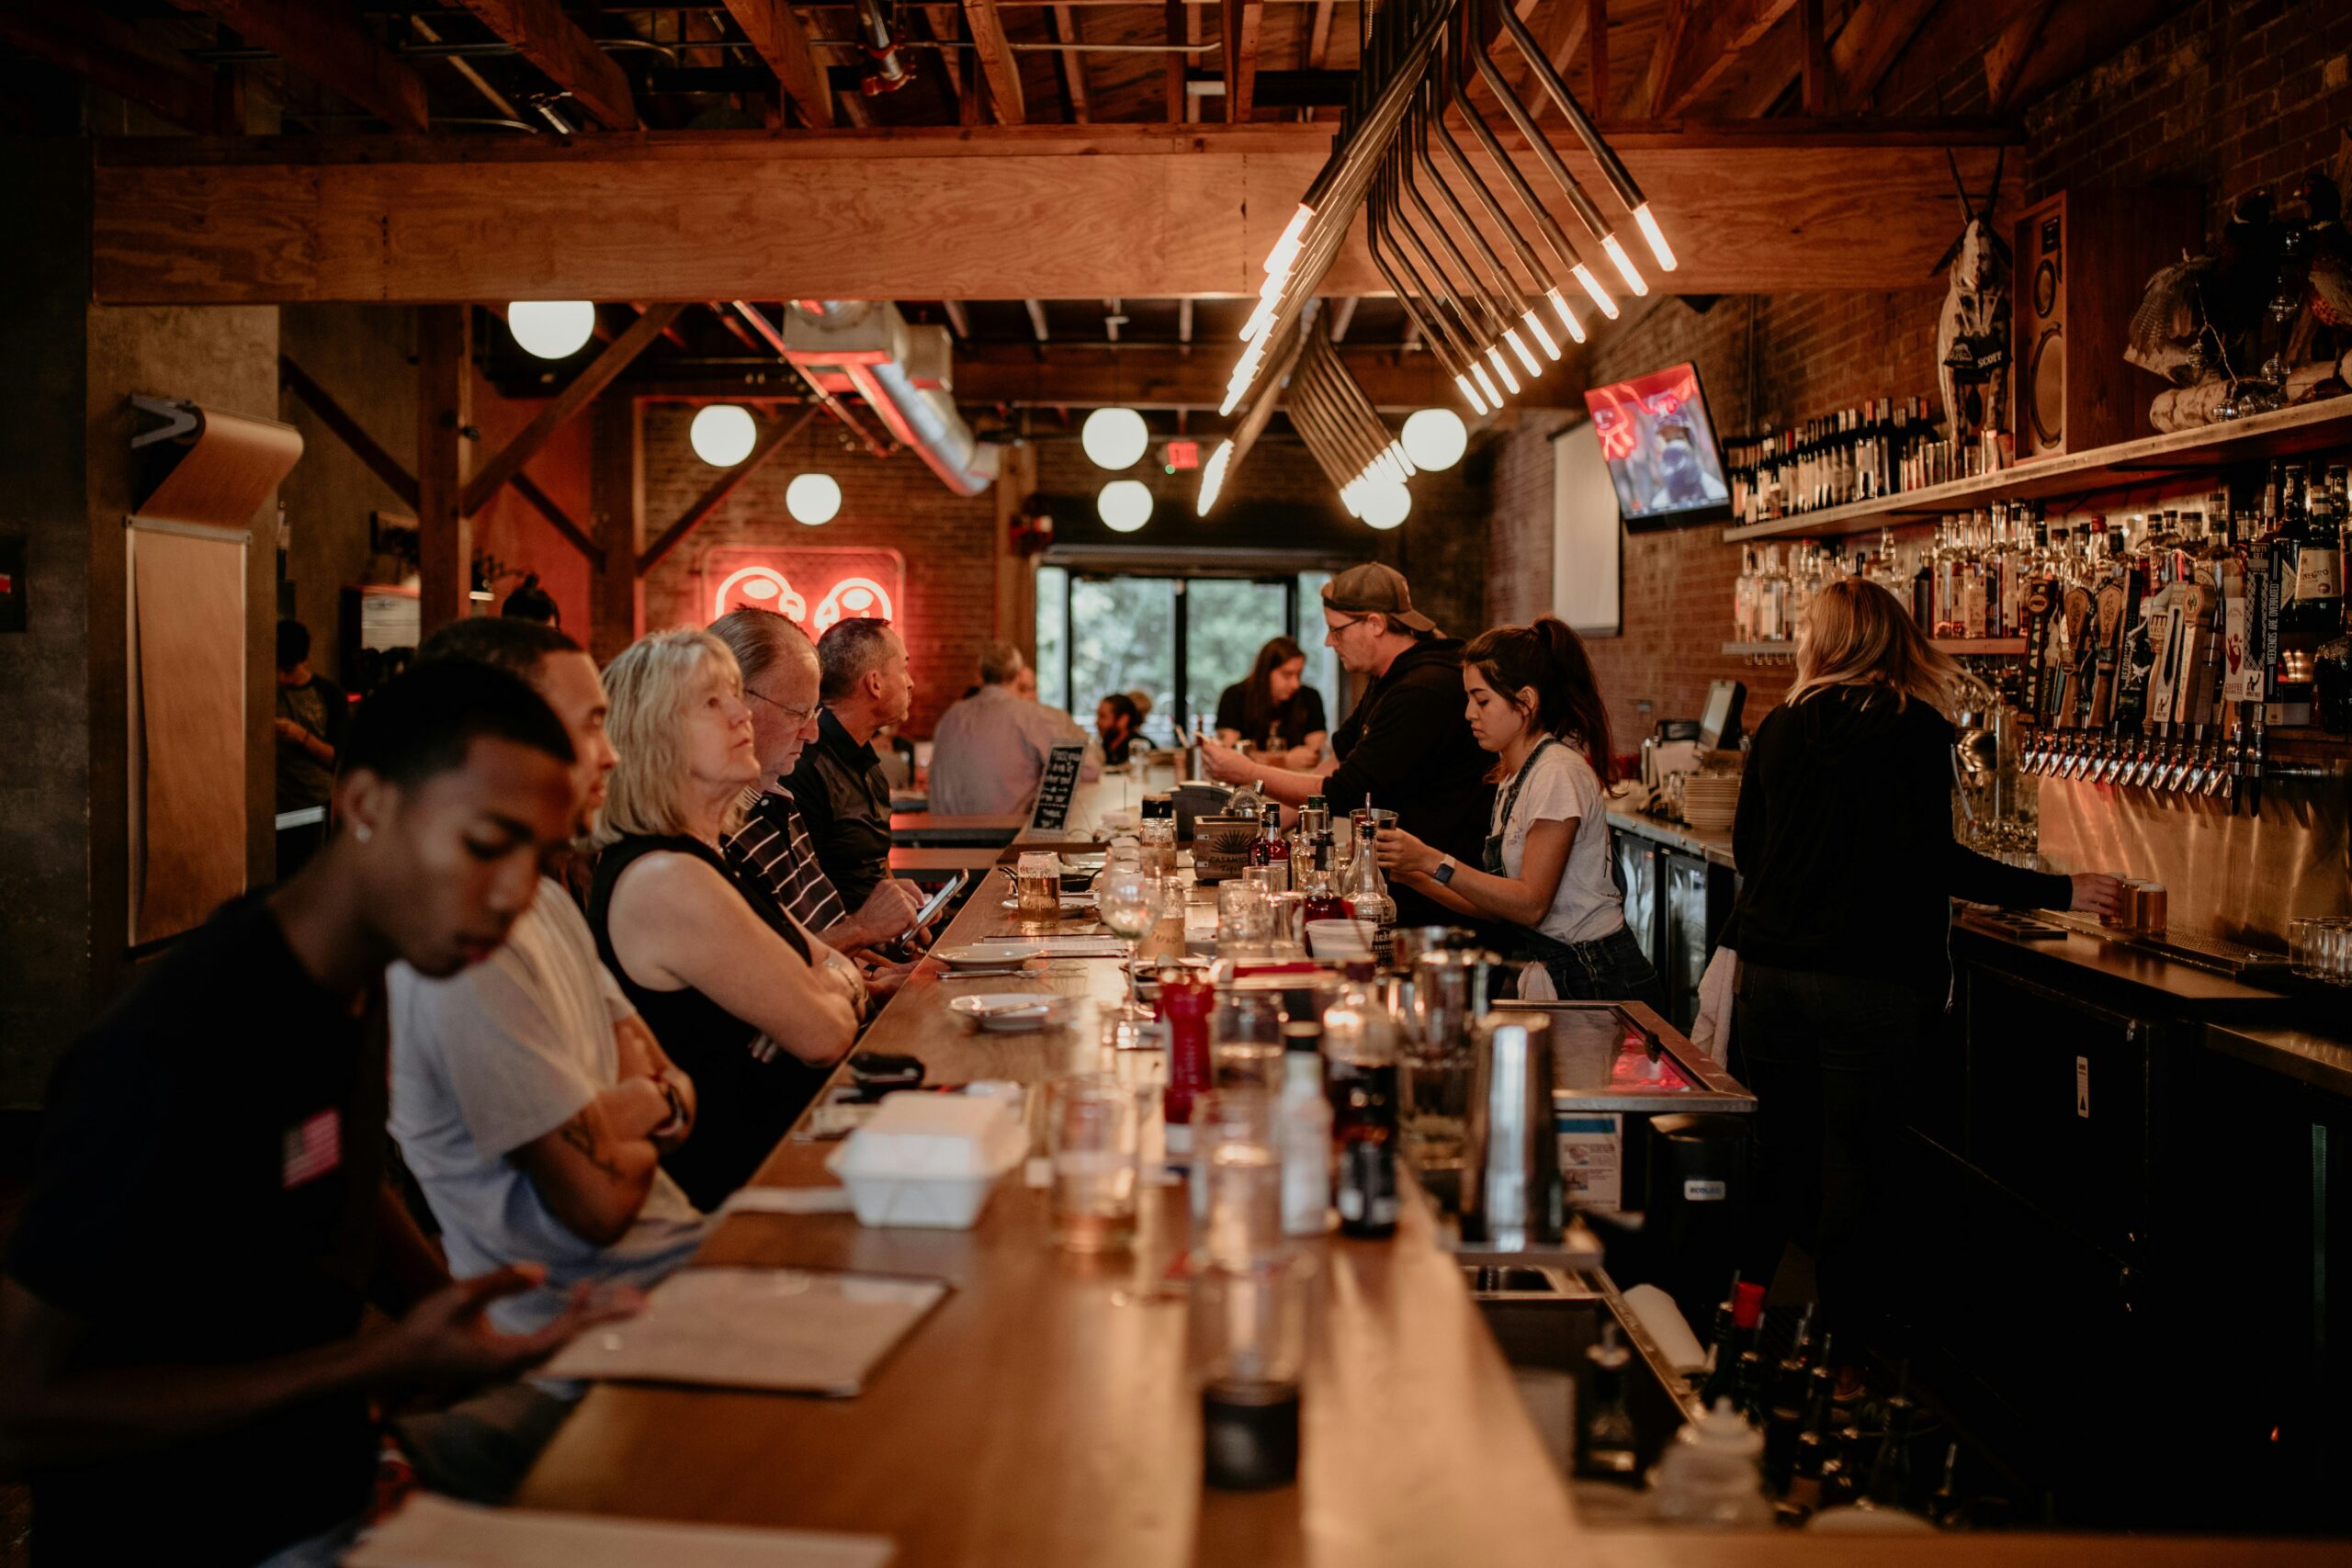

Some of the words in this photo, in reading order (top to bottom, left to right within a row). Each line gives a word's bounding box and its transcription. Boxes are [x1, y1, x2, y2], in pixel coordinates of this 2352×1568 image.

[2268, 583, 2279, 617] OVERRATED
[2268, 618, 2278, 631] ARE
[2267, 632, 2278, 665] WEEKENDS
[2026, 675, 2036, 709] JAI
